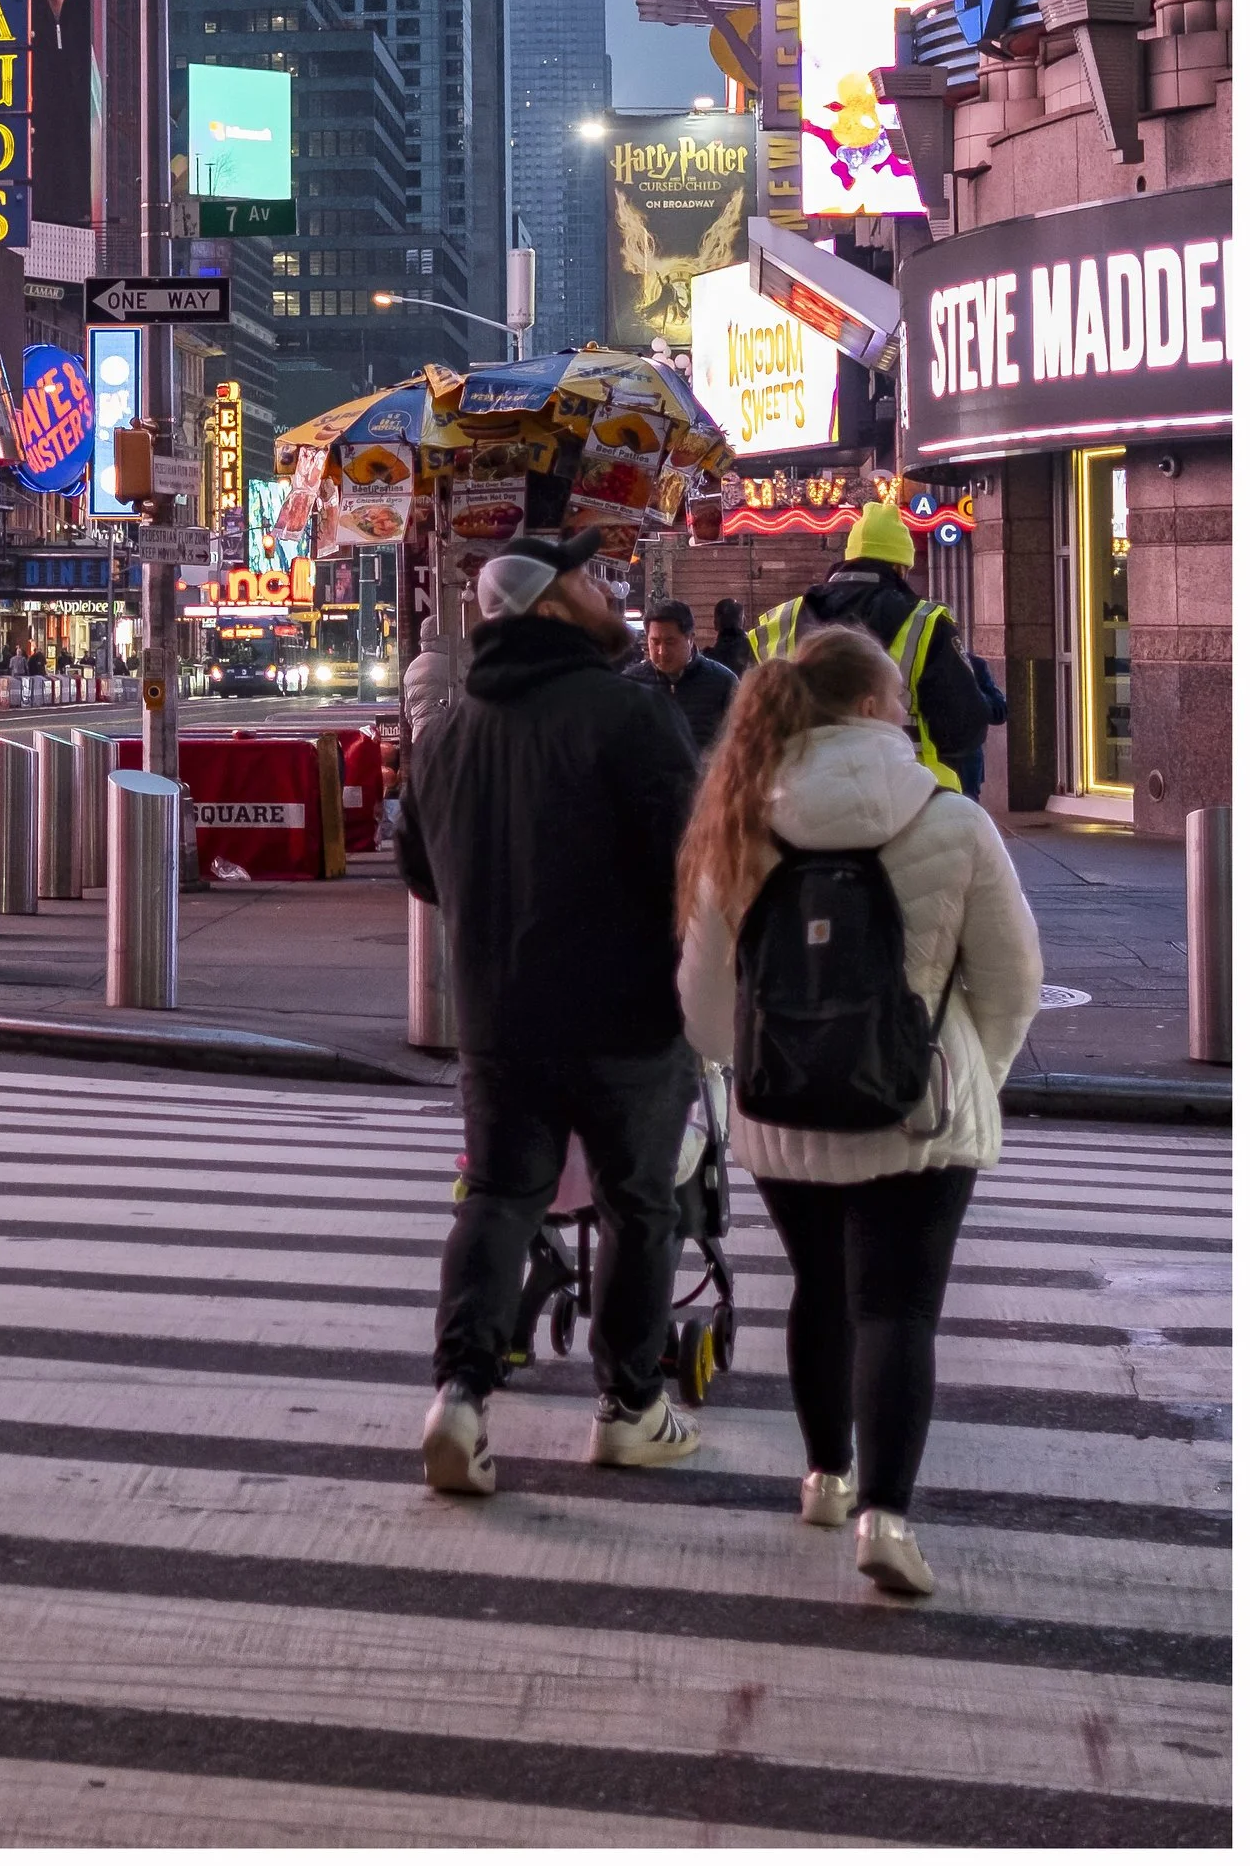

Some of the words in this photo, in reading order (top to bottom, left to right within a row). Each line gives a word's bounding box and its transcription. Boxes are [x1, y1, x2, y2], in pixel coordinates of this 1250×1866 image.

[610, 142, 677, 185] Harry
[678, 136, 748, 187] Potter
[638, 182, 682, 192] CURSED
[685, 180, 722, 191] CHILD
[645, 200, 661, 209] ON
[662, 199, 715, 209] BROADWAY
[225, 206, 238, 232] 7
[29, 285, 59, 298] LAMAR
[107, 290, 148, 310] ONE
[167, 291, 213, 310] WAY
[930, 272, 1021, 400] STEVE
[1031, 239, 1232, 384] MADDE
[728, 317, 804, 387] KINGDOM
[63, 362, 87, 401] &
[741, 378, 806, 443] SWEETS
[219, 408, 237, 509] EMPIR
[596, 443, 617, 455] Beef
[619, 447, 650, 463] Patties
[352, 484, 372, 494] Beef
[375, 484, 403, 493] Patties
[490, 493, 502, 502] Hot
[605, 501, 619, 511] Over
